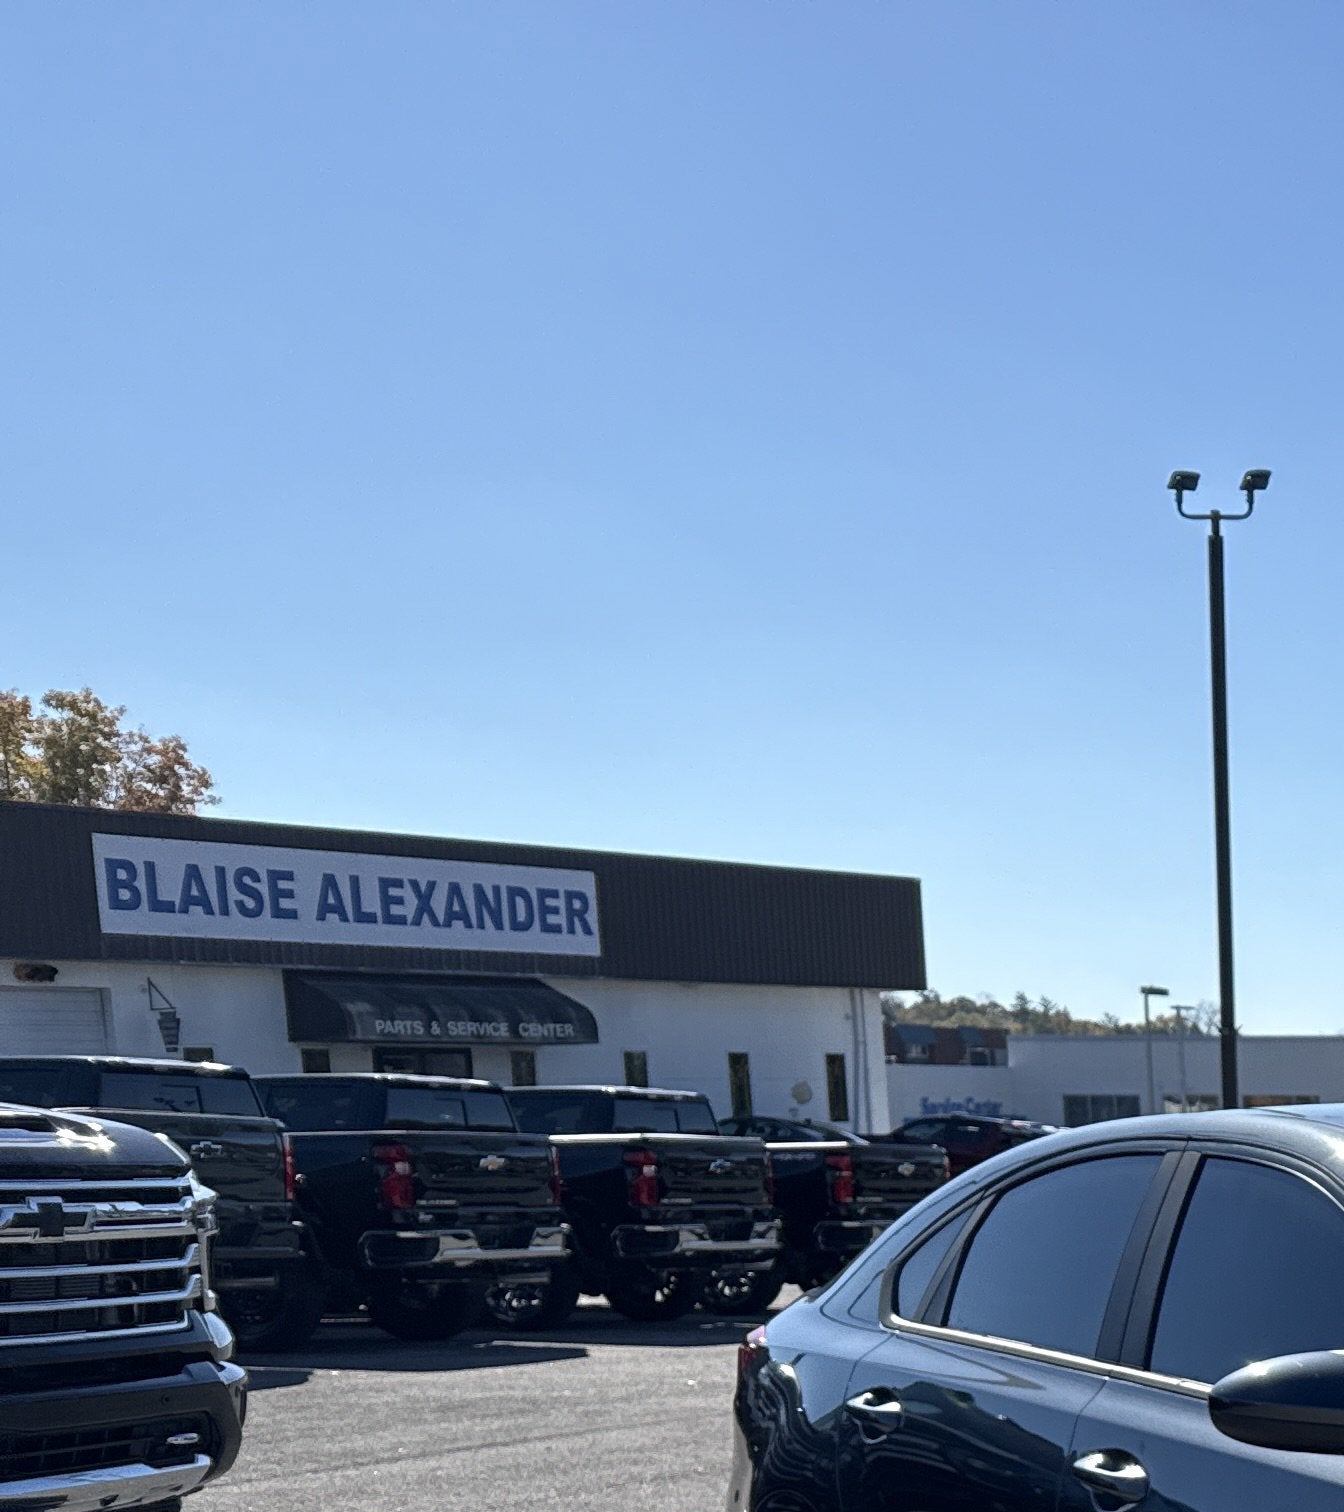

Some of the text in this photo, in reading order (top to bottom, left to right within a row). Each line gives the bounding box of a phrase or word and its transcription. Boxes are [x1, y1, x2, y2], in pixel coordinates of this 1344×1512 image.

[104, 857, 594, 936] BLAISE ALEXANDER
[375, 1020, 575, 1037] PARTS & SERVICE CENTER
